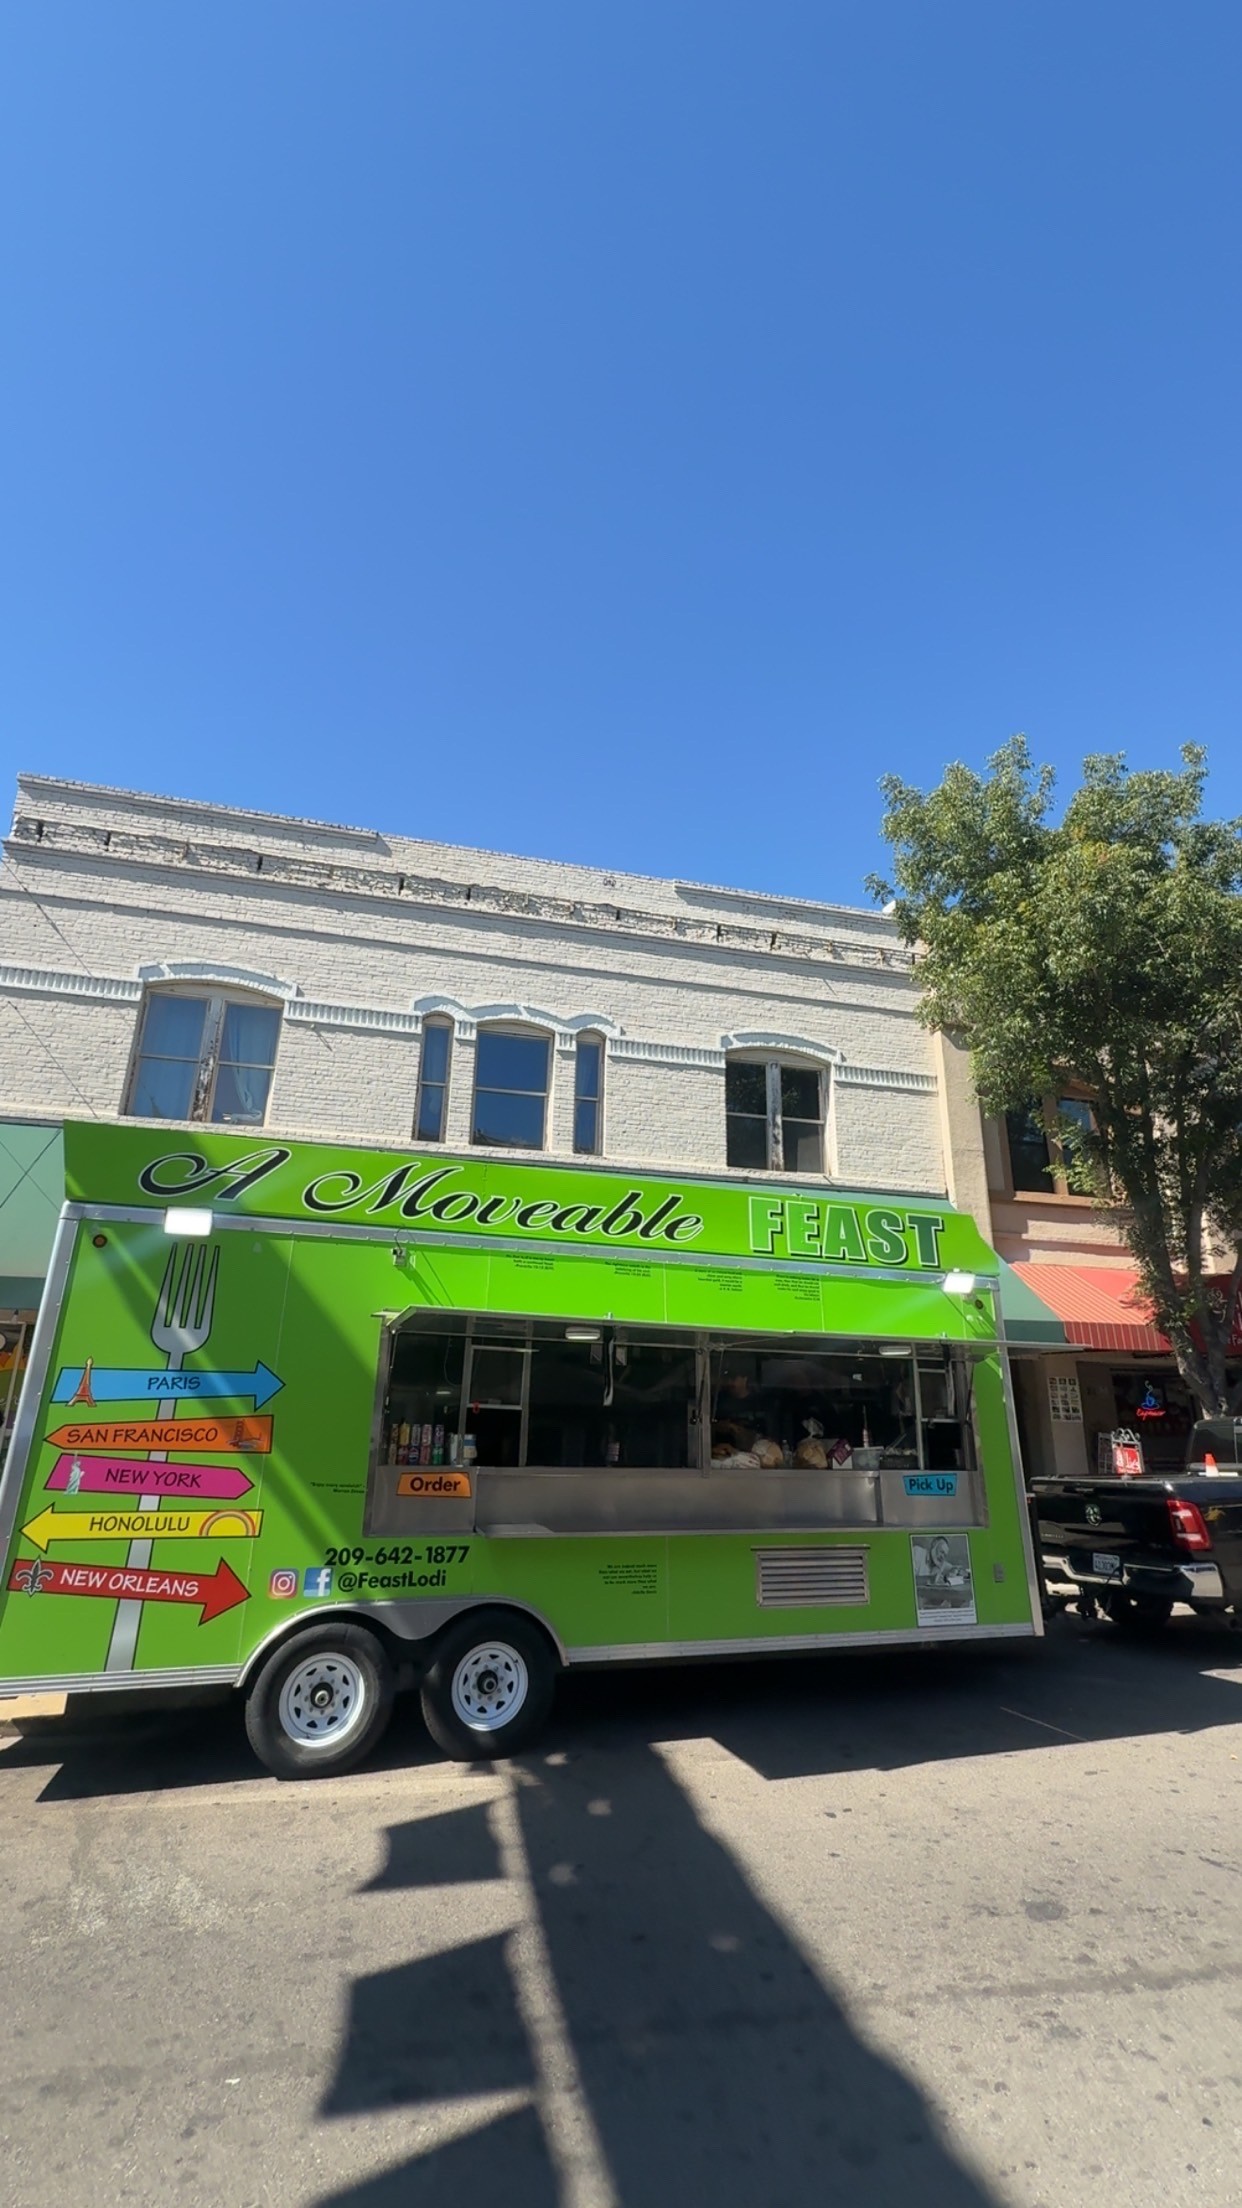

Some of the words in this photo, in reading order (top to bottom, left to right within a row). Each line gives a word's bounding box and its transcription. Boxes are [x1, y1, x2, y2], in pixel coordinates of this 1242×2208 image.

[138, 1146, 292, 1201] A
[302, 1162, 705, 1243] Moveable
[748, 1196, 945, 1268] FEAST
[147, 1375, 201, 1391] PARIS
[66, 1428, 109, 1444] SAN
[112, 1427, 219, 1444] FRANCISCO
[104, 1467, 150, 1485] NEW
[152, 1470, 202, 1488] YORK
[410, 1476, 462, 1492] Order
[909, 1478, 933, 1491] Pick
[936, 1478, 954, 1494] Up
[89, 1515, 191, 1532] HONOLULU
[324, 1546, 471, 1566] 209-642-1877
[59, 1568, 108, 1589] NEW
[108, 1573, 200, 1598] ORLEANS
[338, 1570, 447, 1593] @FeastLodi
